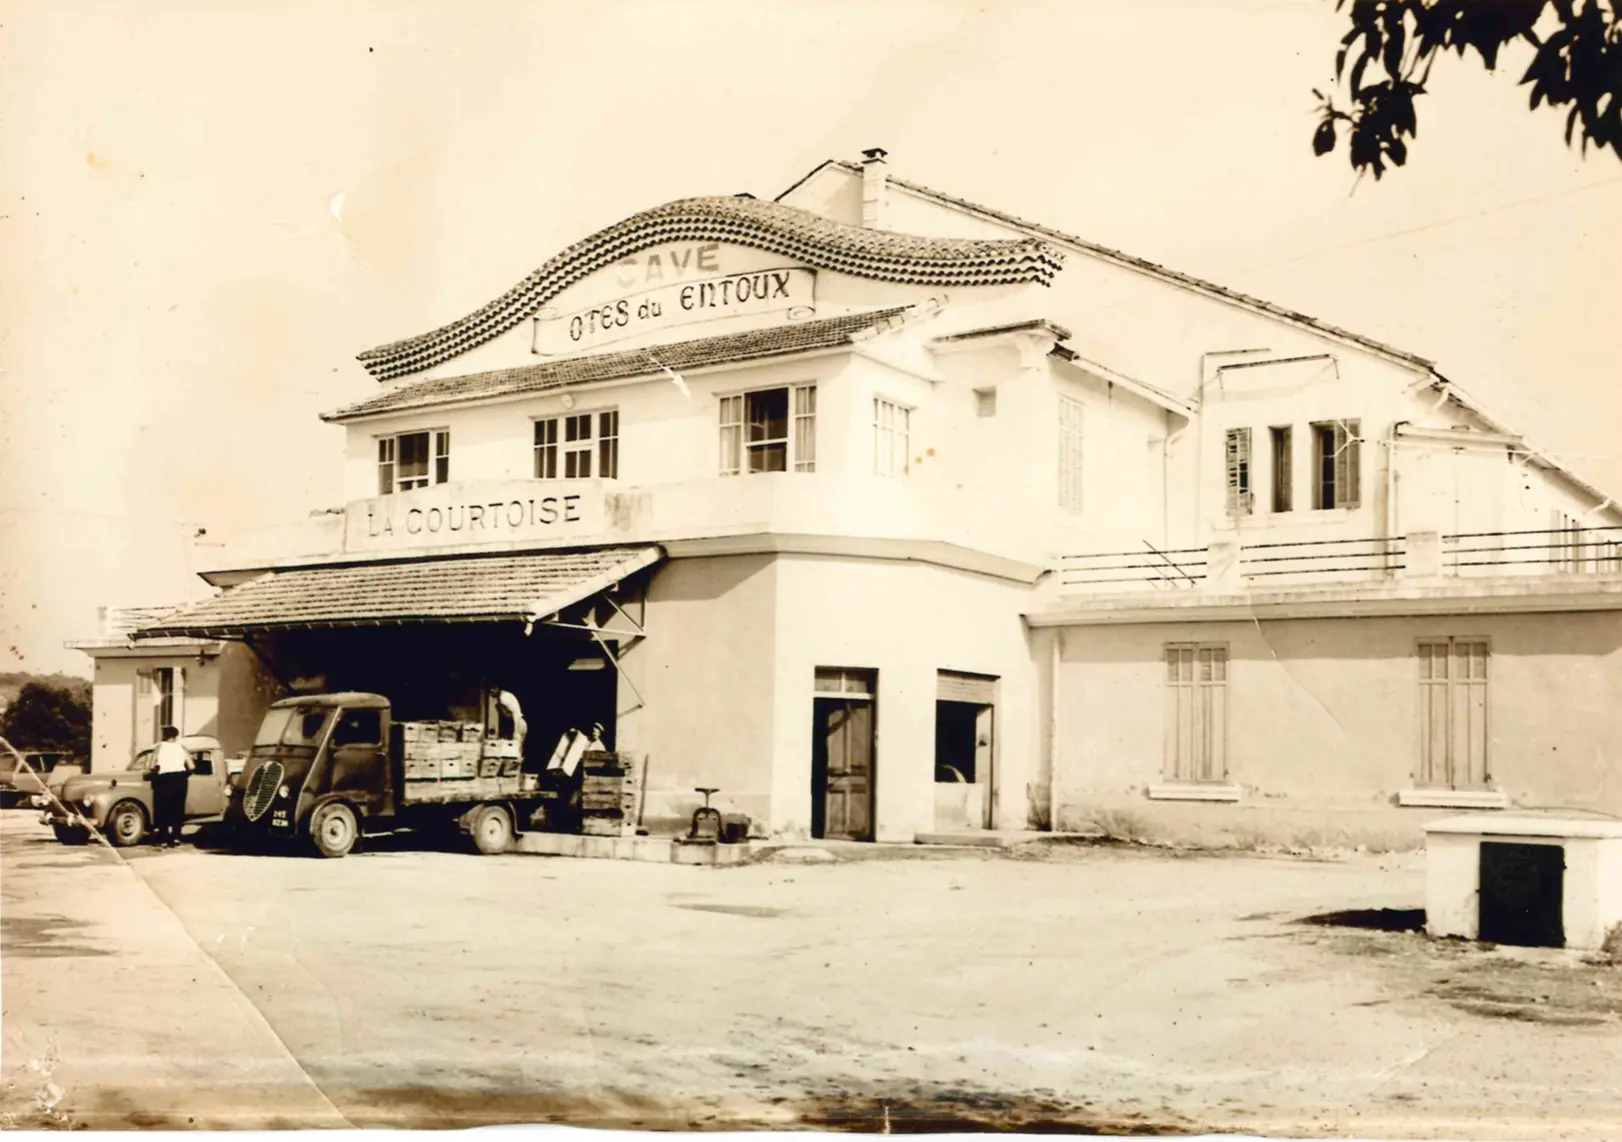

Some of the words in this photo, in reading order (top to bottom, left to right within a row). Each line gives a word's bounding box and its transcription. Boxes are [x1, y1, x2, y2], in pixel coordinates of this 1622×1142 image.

[615, 242, 720, 289] CAVE
[637, 298, 663, 320] du
[367, 512, 395, 538] LA
[405, 494, 581, 535] COURTOISE
